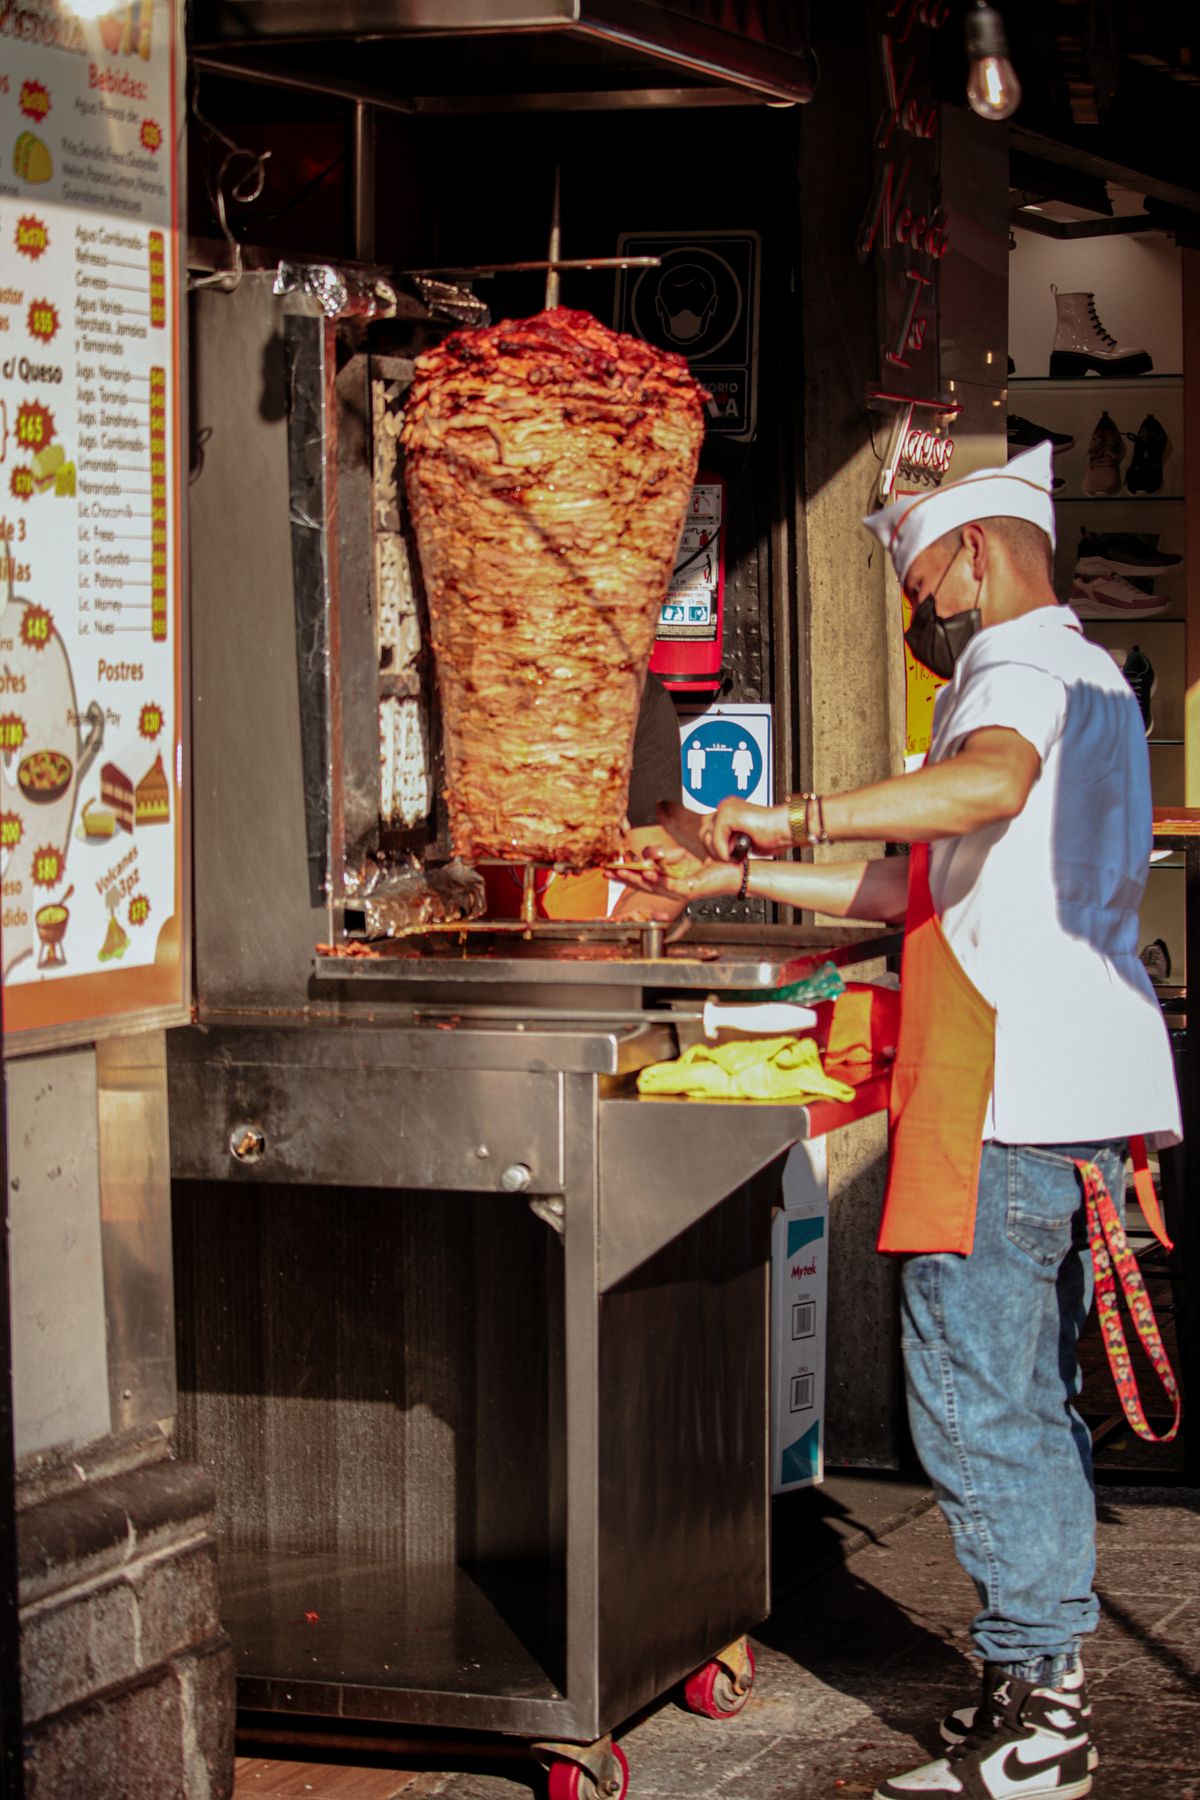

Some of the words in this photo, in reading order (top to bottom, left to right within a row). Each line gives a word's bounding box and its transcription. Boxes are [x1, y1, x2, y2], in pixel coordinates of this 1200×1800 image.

[874, 32, 938, 148] You
[863, 160, 949, 259] Need
[18, 355, 63, 384] Queso
[20, 413, 44, 443] $65
[18, 517, 28, 542] 3
[97, 657, 143, 682] Postres
[791, 1257, 817, 1280] Mytek
